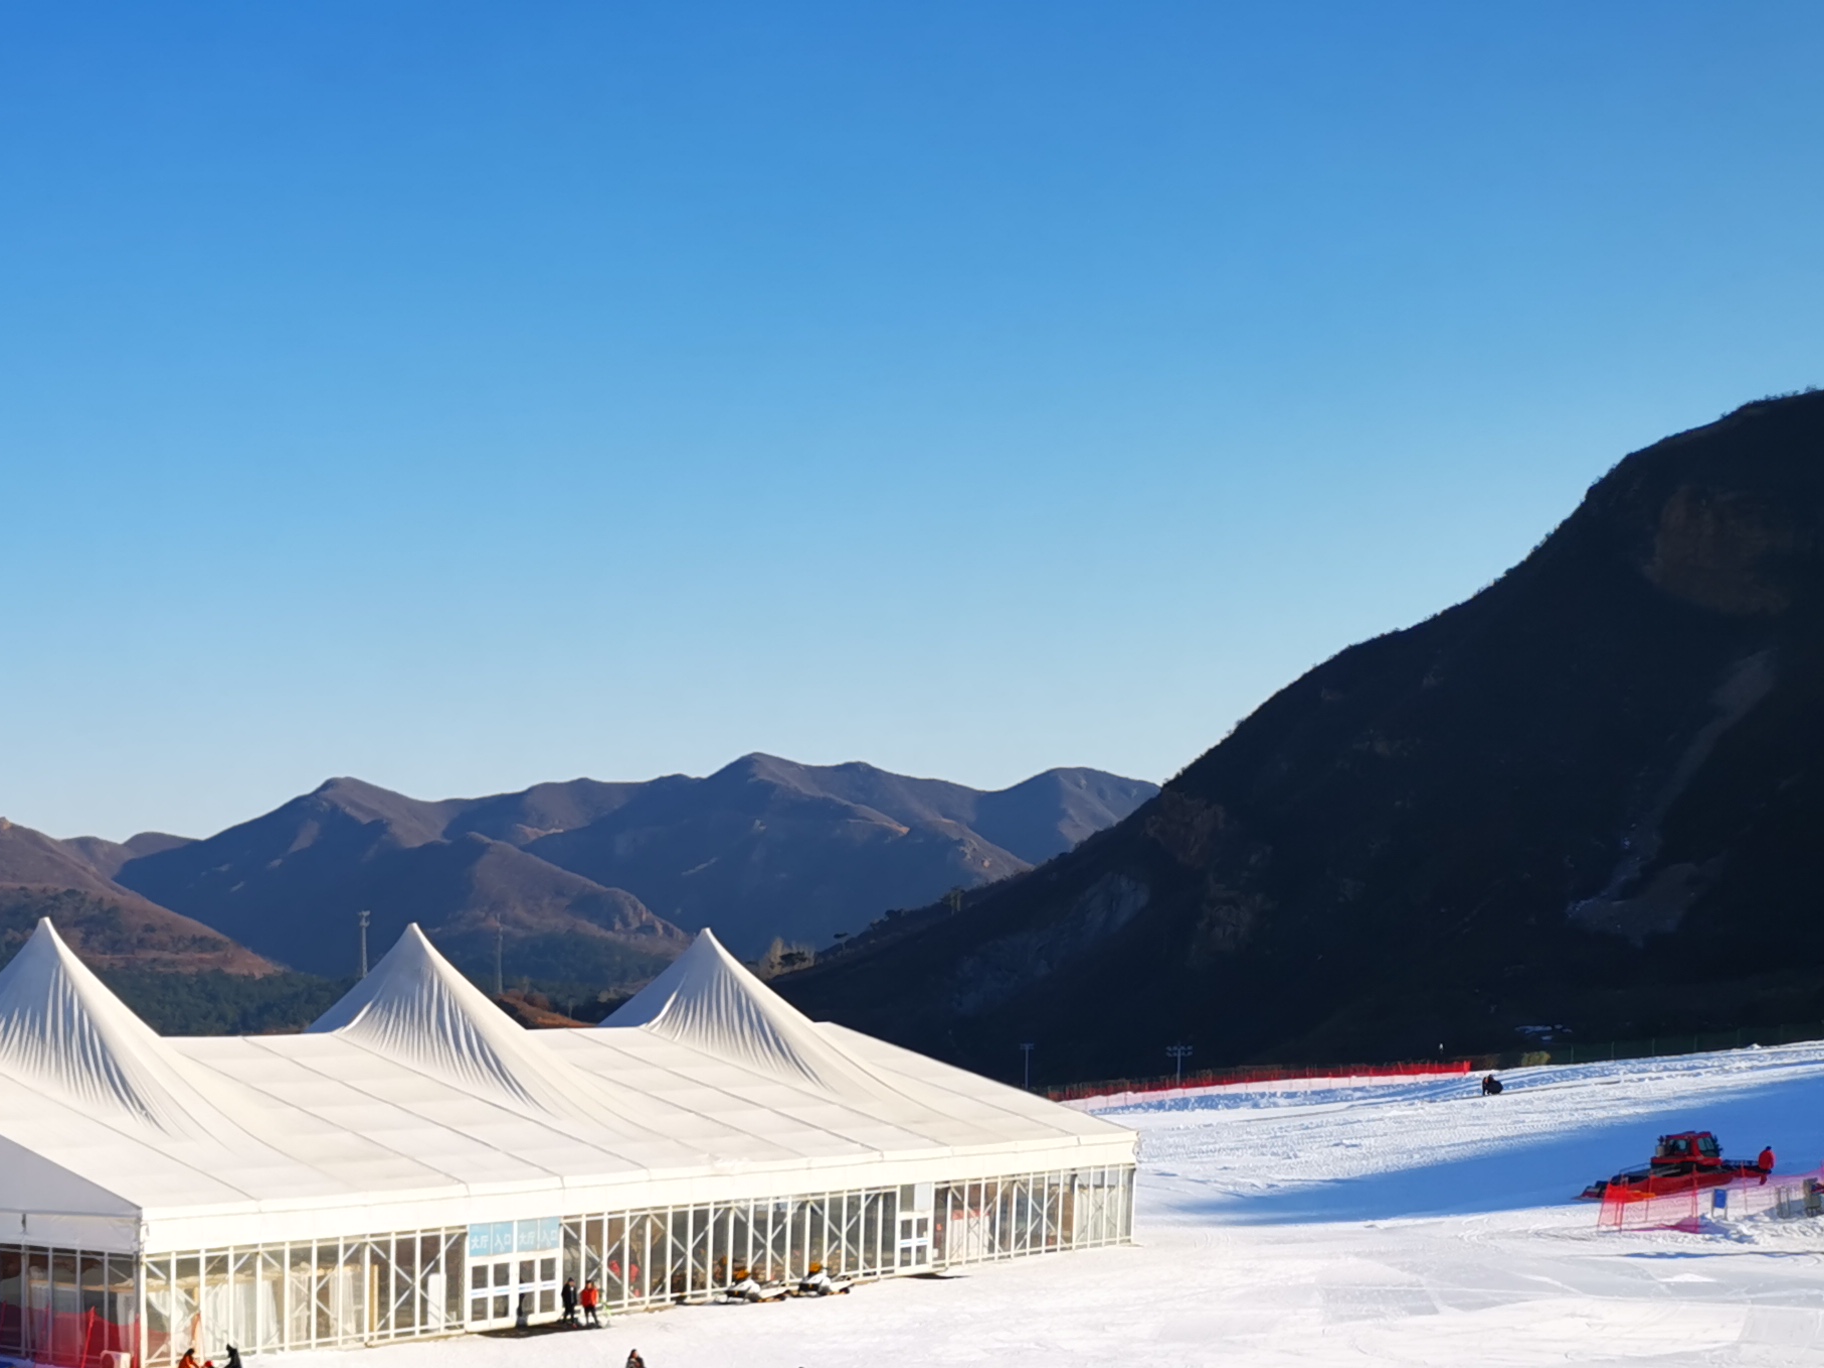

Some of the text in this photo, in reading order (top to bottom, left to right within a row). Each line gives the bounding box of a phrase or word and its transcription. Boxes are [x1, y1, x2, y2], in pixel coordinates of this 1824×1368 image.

[471, 1233, 512, 1251] 大厅入口
[519, 1229, 558, 1246] 大厅入口
